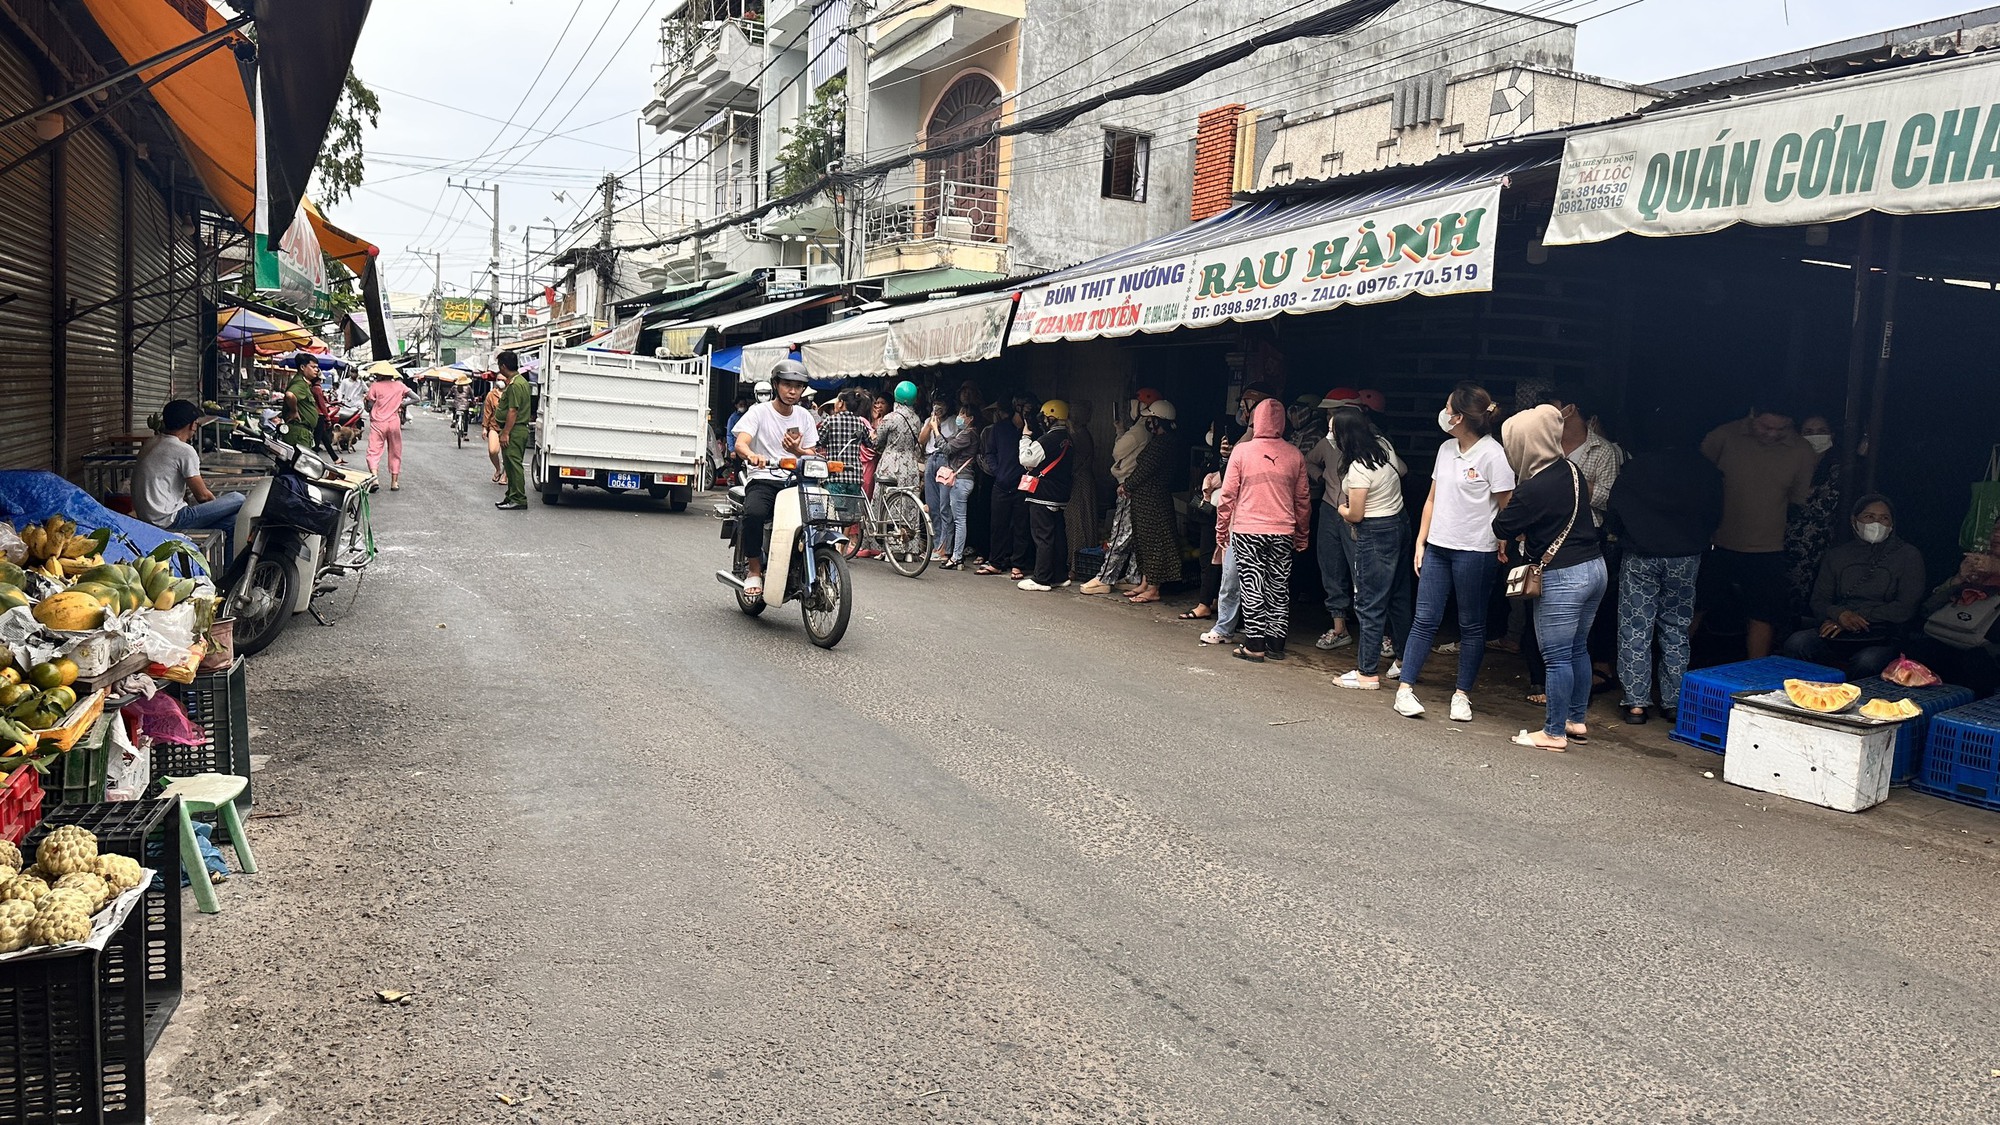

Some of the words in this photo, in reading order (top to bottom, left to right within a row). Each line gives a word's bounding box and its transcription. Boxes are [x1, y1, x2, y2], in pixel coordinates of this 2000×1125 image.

[1602, 165, 1632, 183] LỘC
[1637, 129, 1760, 221] QUÁN
[1764, 115, 1886, 203] CƠM
[1558, 195, 1624, 213] 0982.789315
[1195, 247, 1298, 301] RAU
[1302, 207, 1487, 283] HÀNH
[1044, 285, 1077, 306] BÚN
[1081, 277, 1116, 301] THỊT
[1118, 263, 1186, 295] NƯỚNG
[1192, 307, 1210, 320] ĐT:
[1212, 292, 1297, 317] 0398.921.803
[1312, 286, 1352, 302] ZALO:
[1356, 263, 1479, 295] 0976.770.519
[1034, 313, 1085, 335] THANH
[1087, 294, 1143, 331] TUYỀN
